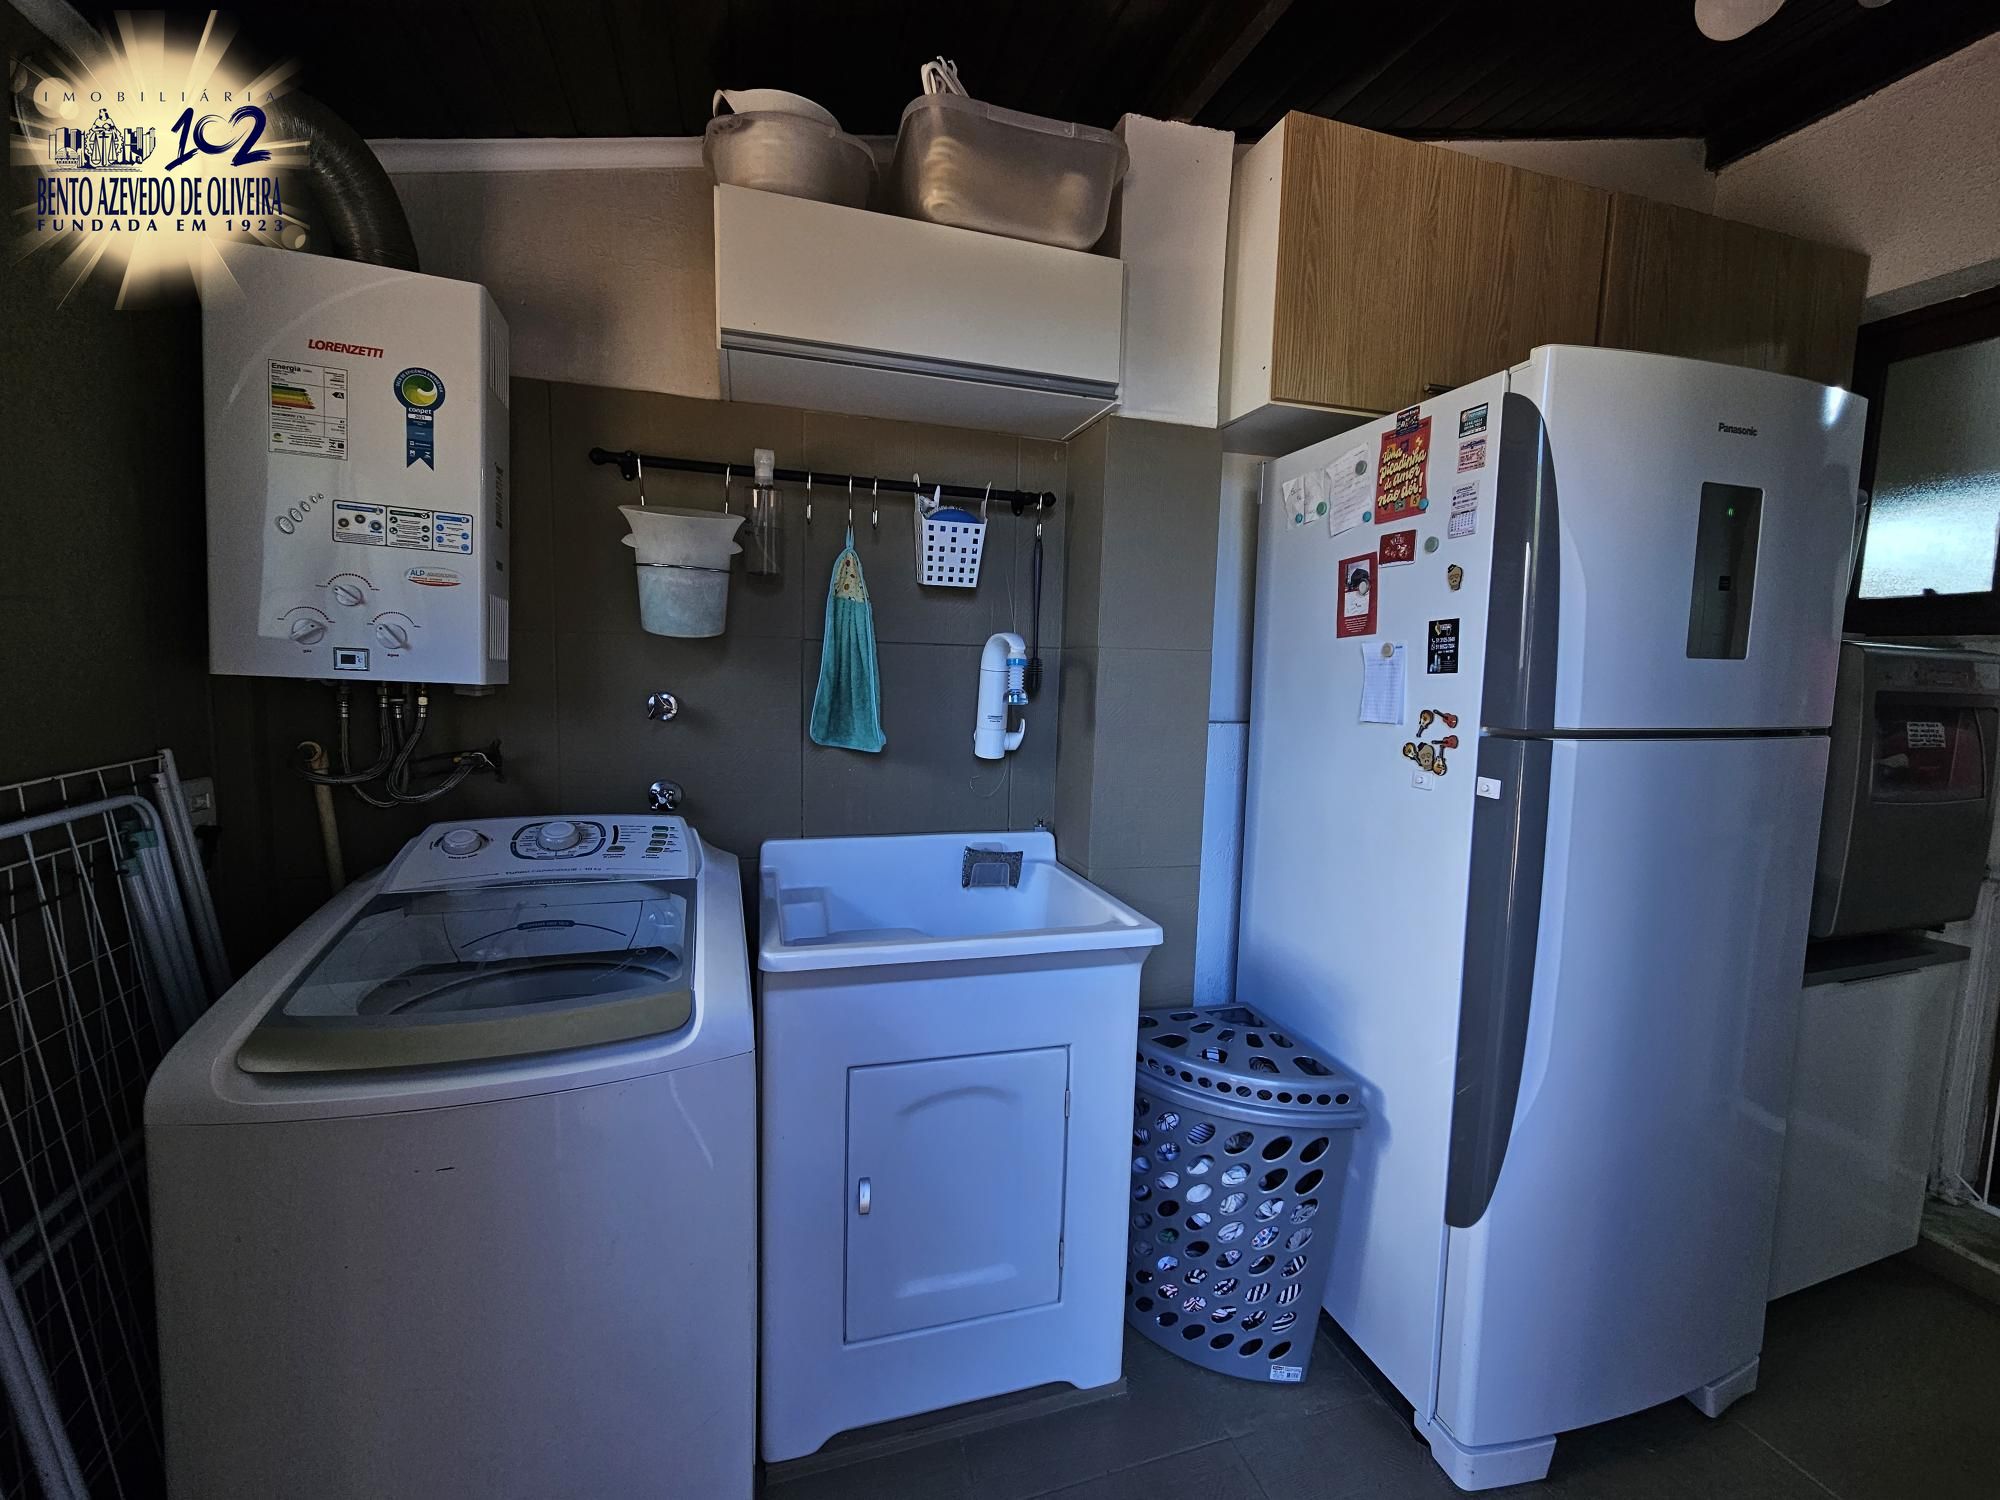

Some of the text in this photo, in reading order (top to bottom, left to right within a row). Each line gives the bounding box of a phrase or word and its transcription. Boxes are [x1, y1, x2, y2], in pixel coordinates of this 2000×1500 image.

[308, 338, 384, 359] LORENZETTI
[271, 362, 301, 373] Energia
[1718, 422, 1758, 436] Panasonic
[1392, 464, 1421, 486] amor
[1378, 488, 1401, 507] não
